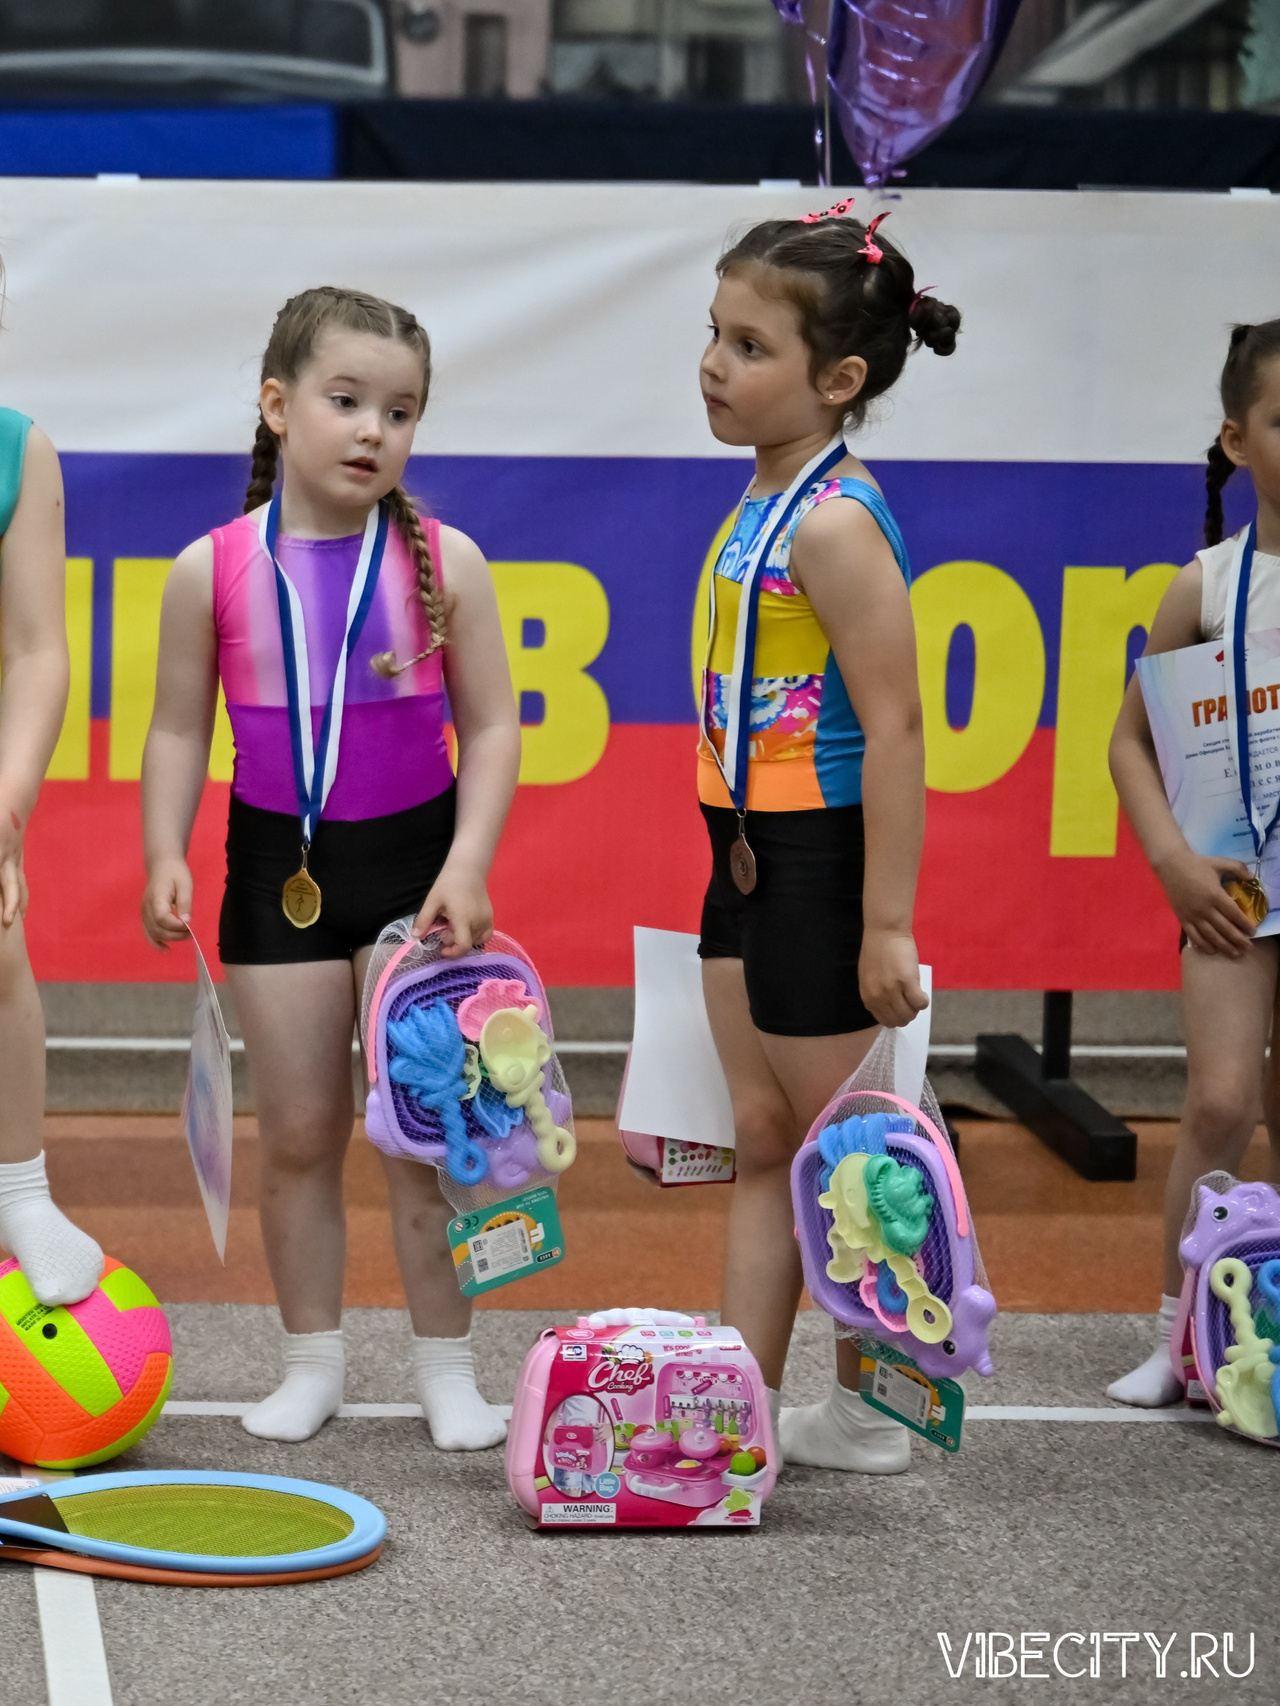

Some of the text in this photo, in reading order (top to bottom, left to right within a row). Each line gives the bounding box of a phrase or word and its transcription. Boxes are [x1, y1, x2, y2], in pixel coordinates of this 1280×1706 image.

[1192, 684, 1280, 727] ГРАОТ
[588, 1361, 651, 1389] Chef
[607, 1381, 634, 1391] Cooking
[563, 1505, 613, 1513] WARNING:
